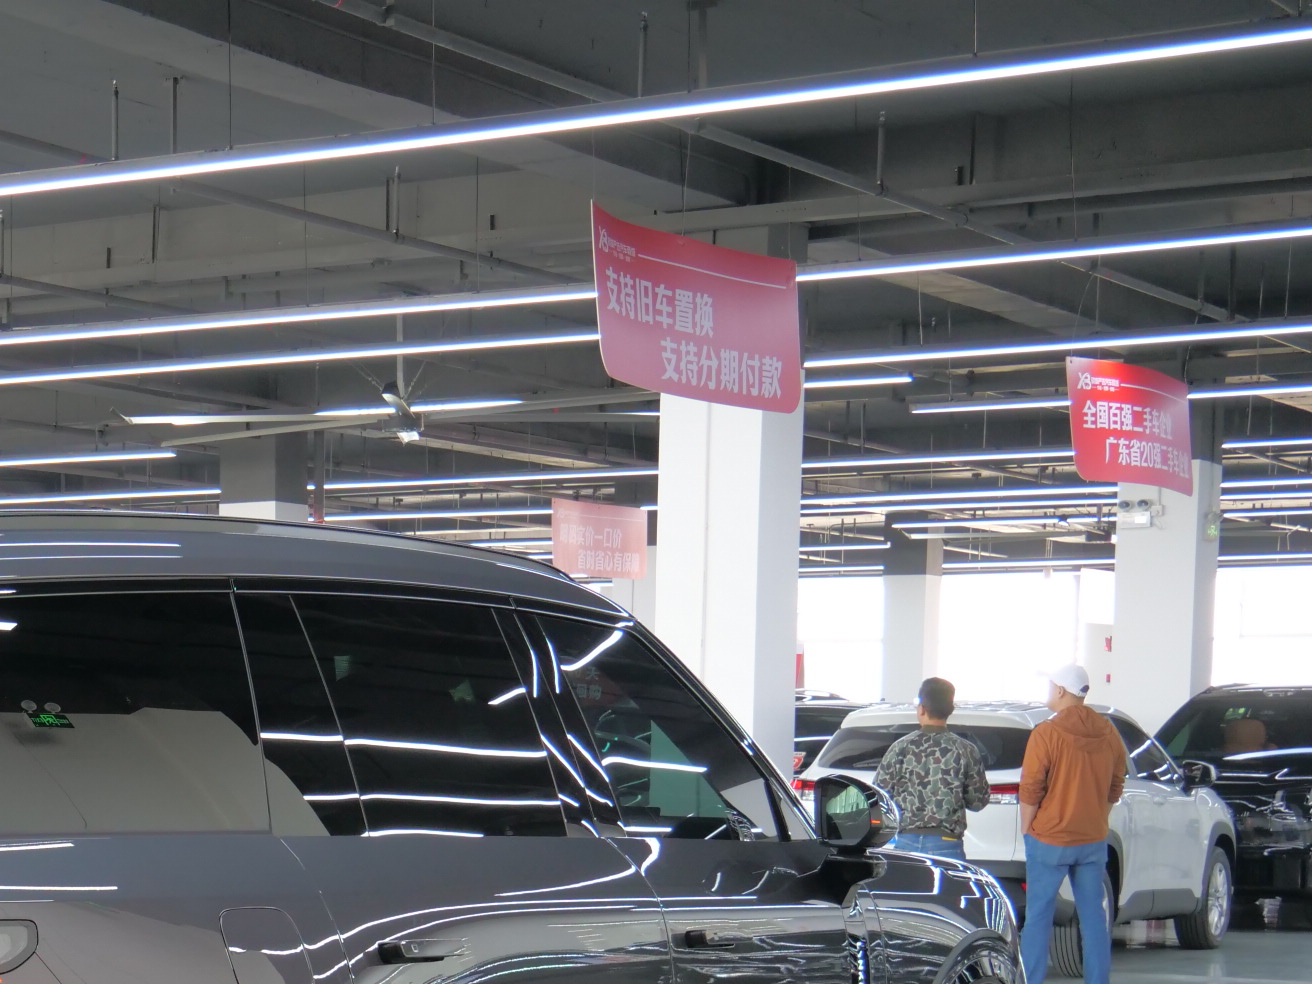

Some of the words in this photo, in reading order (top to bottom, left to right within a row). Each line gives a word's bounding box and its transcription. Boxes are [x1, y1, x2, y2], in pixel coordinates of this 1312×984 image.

[605, 266, 714, 338] 支持旧车置换
[660, 337, 783, 399] 支持分期付款
[1082, 400, 1173, 440] 全国百强二手车企业
[1105, 437, 1191, 479] 广东省20强二手车企业
